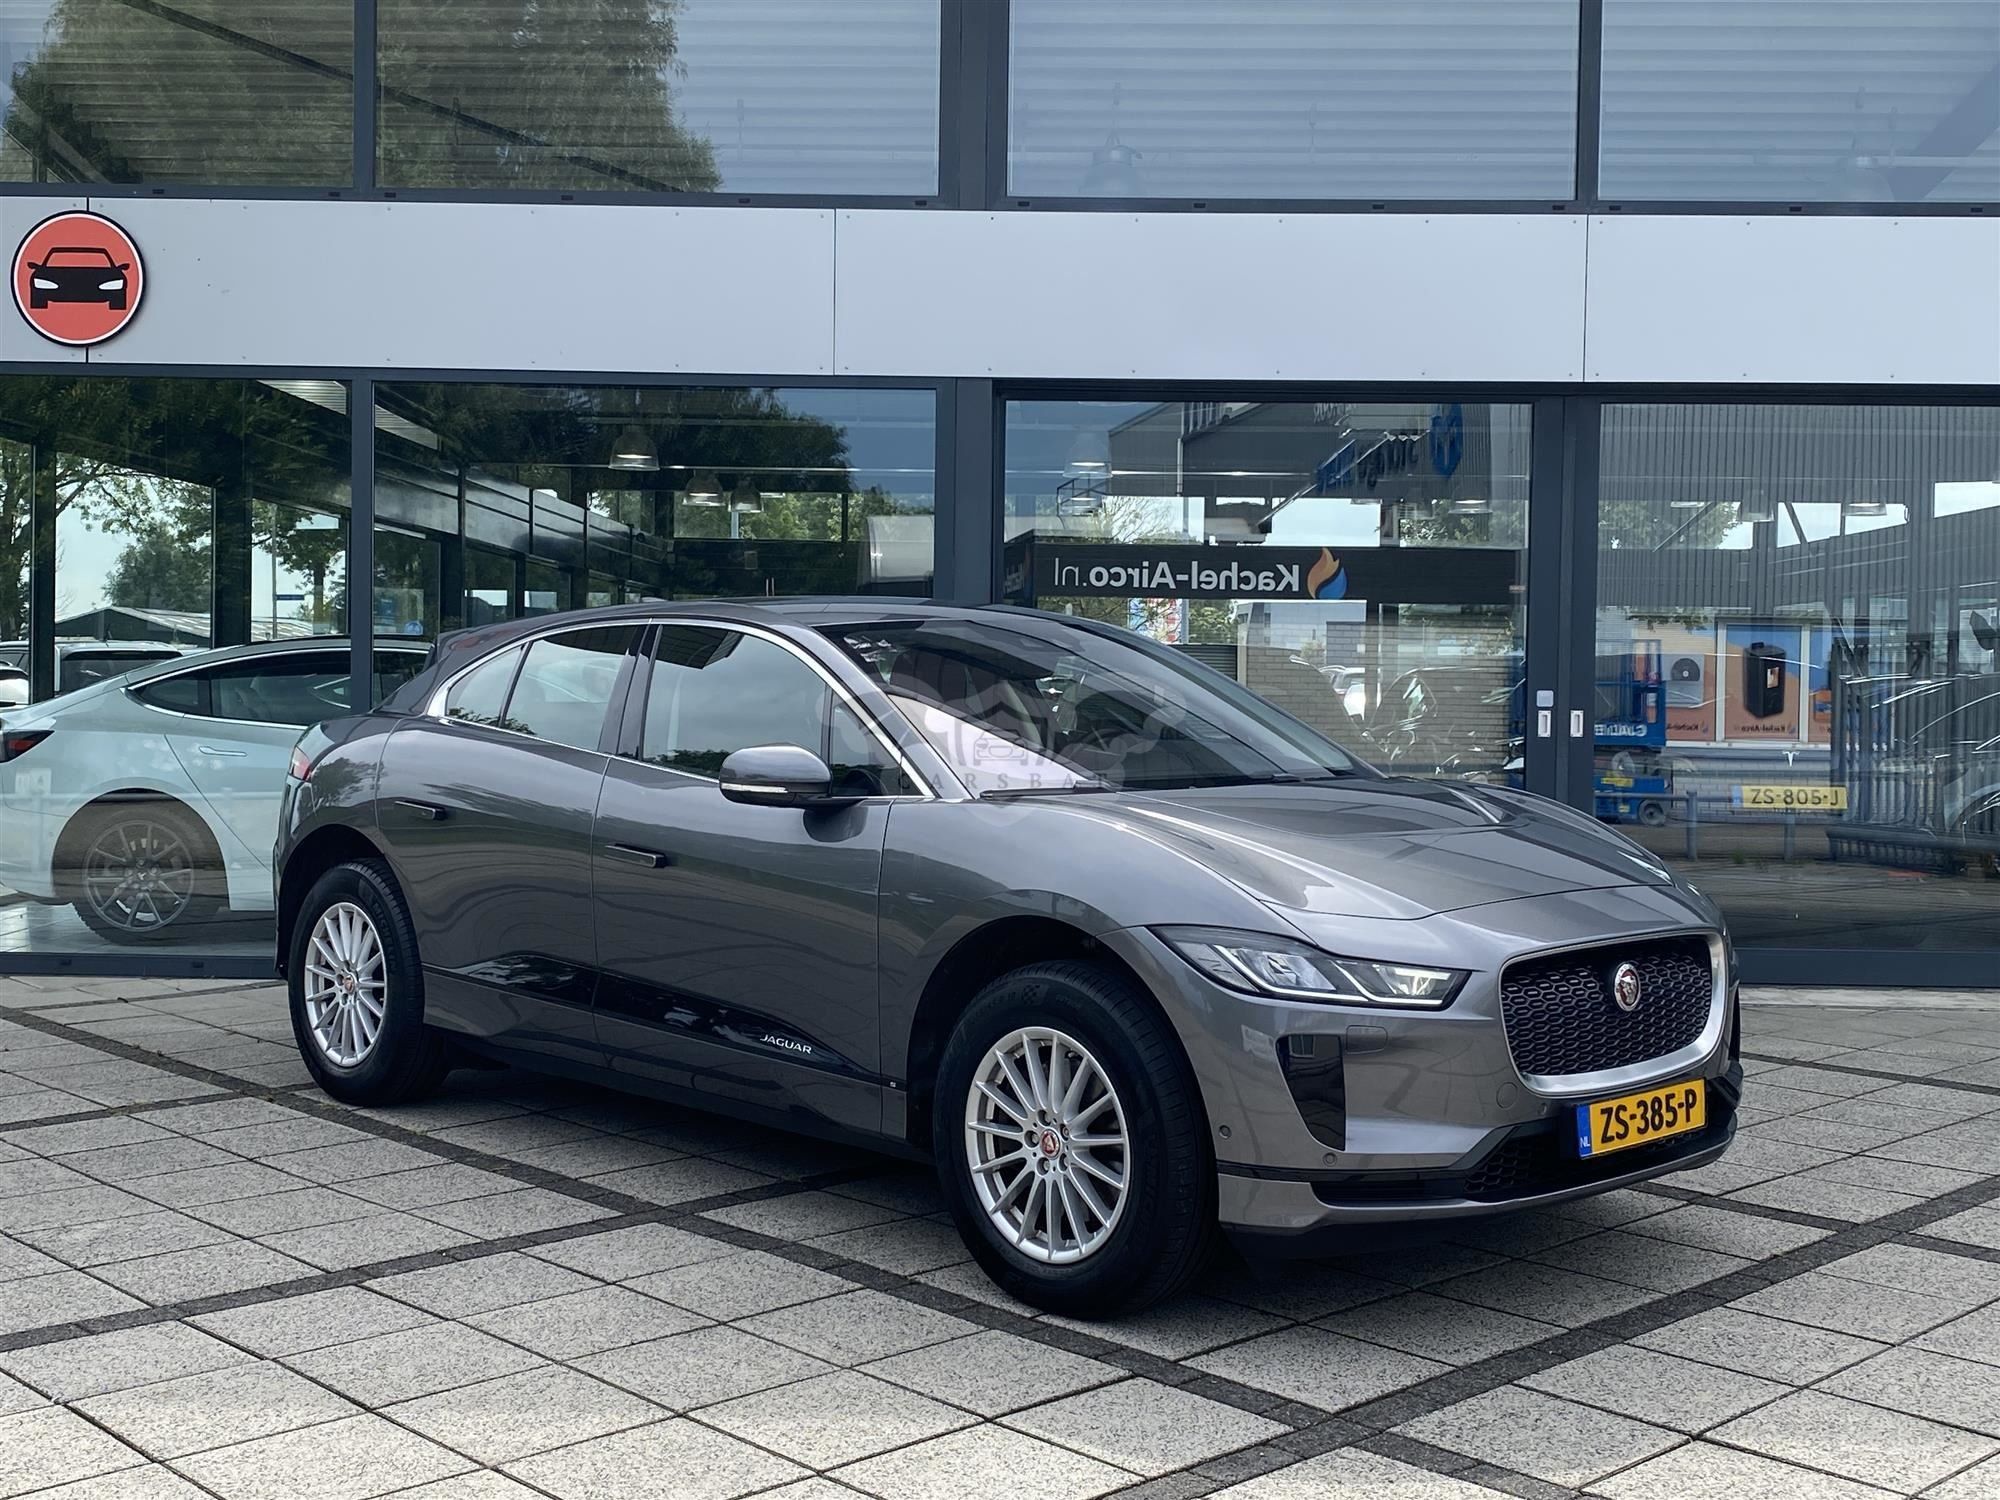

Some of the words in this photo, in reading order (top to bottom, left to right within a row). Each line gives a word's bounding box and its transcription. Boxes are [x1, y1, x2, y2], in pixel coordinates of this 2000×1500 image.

[1751, 788, 1839, 806] ZS-805-J
[760, 1034, 812, 1054] JAGUAR
[1600, 1088, 1697, 1144] ZS-385-P
[1580, 1137, 1591, 1147] NL
